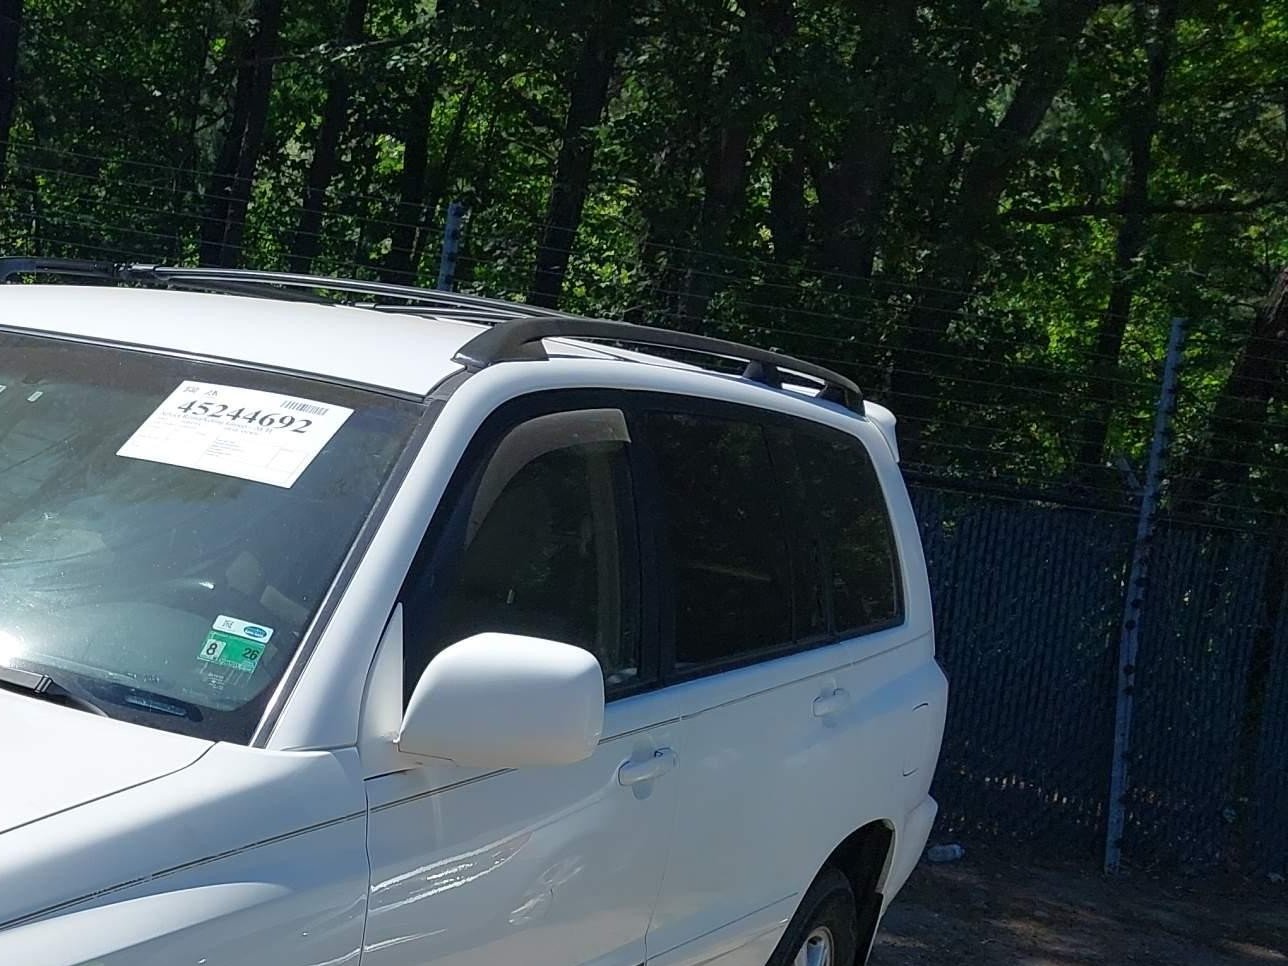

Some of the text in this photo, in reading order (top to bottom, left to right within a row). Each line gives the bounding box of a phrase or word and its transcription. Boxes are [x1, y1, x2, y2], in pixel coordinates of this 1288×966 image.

[177, 399, 313, 434] 45244692
[206, 642, 218, 656] 8
[242, 647, 259, 661] 26
